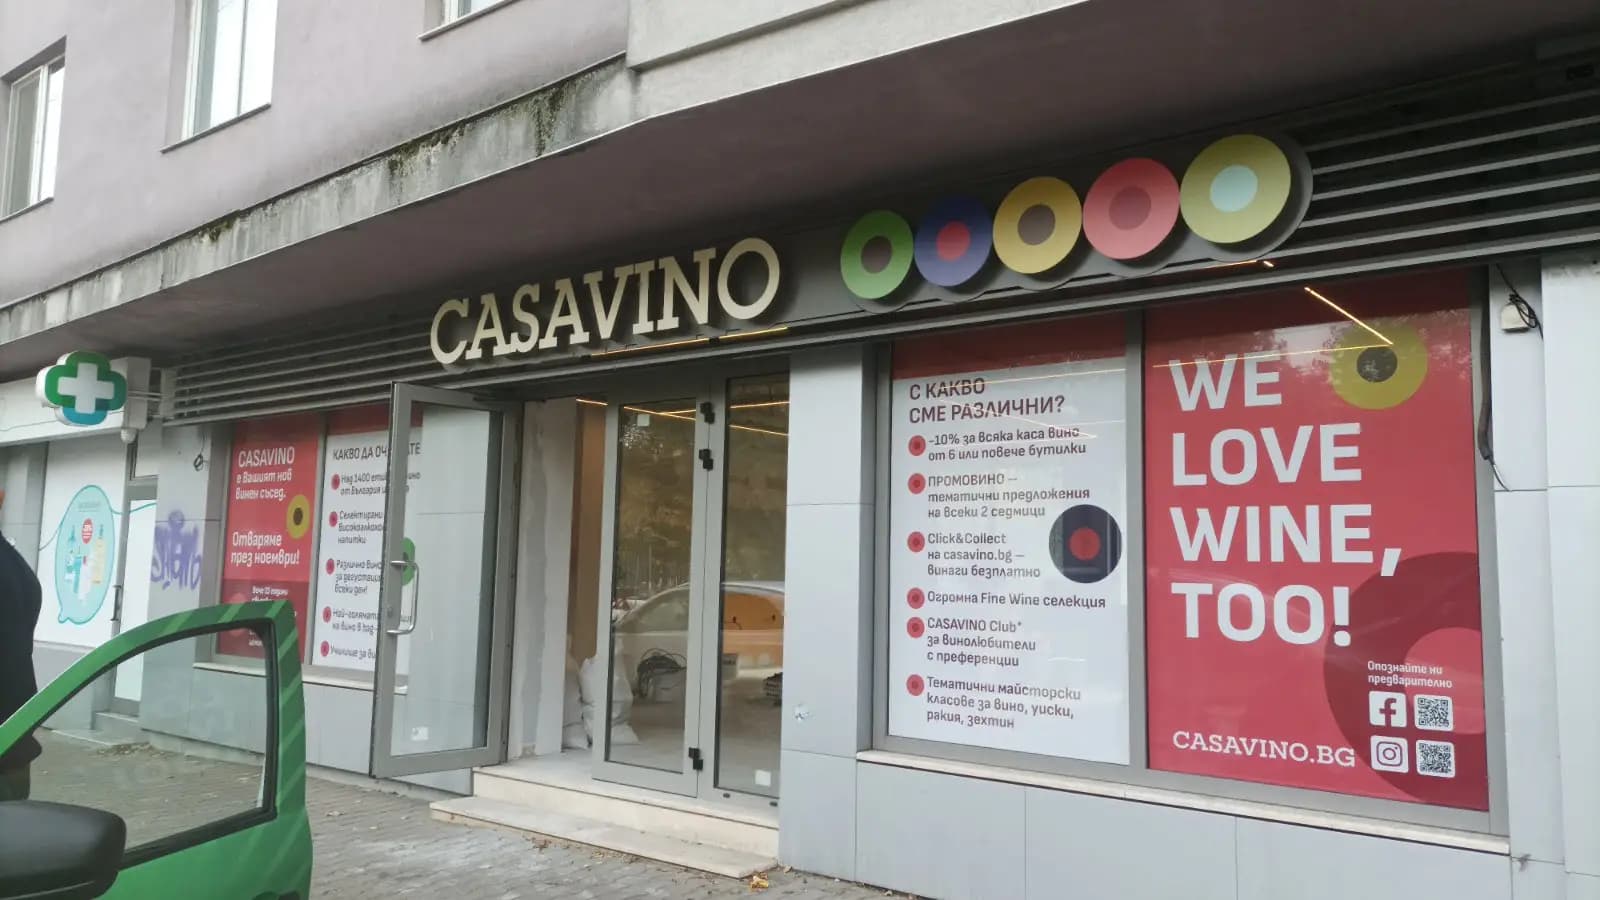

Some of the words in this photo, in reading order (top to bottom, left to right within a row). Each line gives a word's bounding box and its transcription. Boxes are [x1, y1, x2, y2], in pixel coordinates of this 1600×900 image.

[431, 238, 780, 364] CASAVINO
[909, 384, 921, 400] С
[926, 378, 985, 399] КАКВО
[1168, 350, 1282, 411] WE
[909, 405, 946, 424] СМЕ
[951, 395, 1065, 421] РАЗЛИЧНИ?
[963, 432, 976, 445] за
[978, 429, 1014, 443] всяка
[1016, 428, 1045, 440] каса
[1048, 426, 1080, 439] вино
[238, 446, 295, 468] CASAVINO
[333, 447, 360, 460] КАКВО
[361, 447, 373, 460] ДА
[928, 451, 945, 461] от
[948, 450, 956, 460] 6
[958, 449, 979, 460] или
[982, 446, 1026, 458] повече
[1029, 442, 1086, 457] бутилки
[1172, 423, 1362, 486] LOVE
[277, 468, 292, 481] нов
[354, 472, 371, 482] 1400
[928, 473, 1005, 487] ПРОМОВИНО
[928, 491, 1000, 503] тематични
[1002, 488, 1090, 503] предложения
[928, 508, 941, 518] на
[944, 507, 978, 518] всеки
[981, 506, 988, 517] 2
[991, 506, 1045, 519] седмици
[232, 530, 282, 549] Отваряме
[928, 532, 1007, 545] Click&Collect
[1169, 504, 1402, 577] WINE,
[231, 551, 253, 568] през
[255, 549, 300, 568] ноември!
[928, 550, 941, 560] на
[944, 549, 1013, 563] casavino.bg
[928, 564, 968, 577] винаги
[971, 564, 1041, 579] безплатно
[928, 591, 978, 605] Огромна
[981, 592, 1006, 605] Fine
[1009, 593, 1040, 606] Wine
[1043, 594, 1106, 609] селекция
[1171, 582, 1351, 647] TOO!
[927, 617, 987, 632] CASAVINO
[927, 635, 940, 648] за
[942, 634, 1036, 651] винолюбители
[927, 651, 934, 661] с
[936, 652, 1020, 667] преференции
[1368, 660, 1428, 676] Опознайте
[1430, 664, 1443, 676] ни
[927, 676, 995, 693] Тематични
[998, 682, 1082, 701] майсторски
[1368, 673, 1453, 690] предварително
[927, 692, 975, 708] класове
[978, 699, 991, 712] за
[994, 698, 1028, 715] вино,
[1031, 704, 1075, 719] уиски,
[927, 709, 964, 726] ракия,
[967, 713, 1015, 729] зехтин
[1173, 731, 1356, 768] CASAVINO.BG
